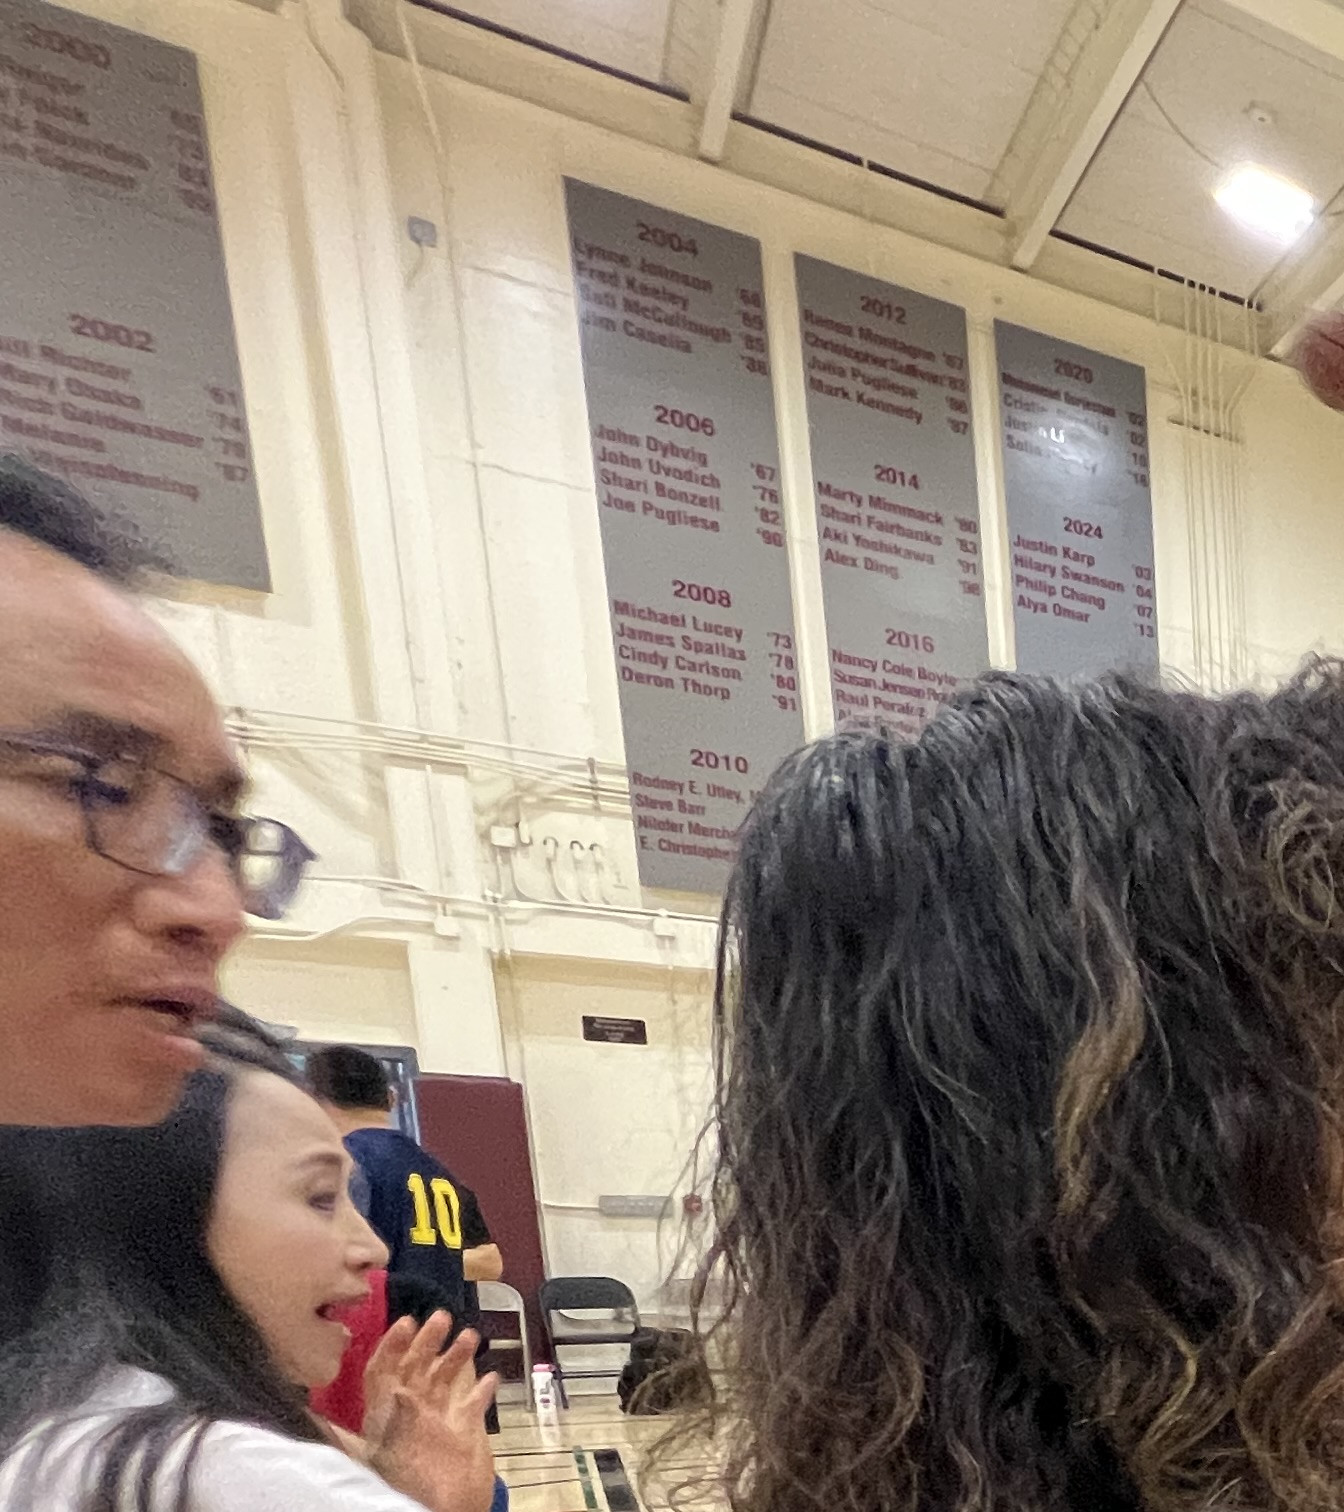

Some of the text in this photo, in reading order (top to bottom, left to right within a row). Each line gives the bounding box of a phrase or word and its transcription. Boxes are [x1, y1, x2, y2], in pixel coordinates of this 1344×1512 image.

[635, 218, 699, 258] 2004
[859, 294, 908, 326] 2012
[68, 312, 158, 354] 2002
[1054, 357, 1095, 385] 2020
[809, 375, 852, 401] Mark
[653, 402, 717, 438] 2006
[599, 446, 644, 472] John
[873, 463, 921, 492] 2014
[817, 480, 864, 509] Marty
[1063, 516, 1105, 541] 2024
[824, 547, 860, 569] Alex
[1013, 534, 1059, 557] Justin
[1061, 545, 1097, 569] Karp
[1014, 553, 1058, 580] Hilary
[1061, 564, 1126, 594] Swanson
[671, 577, 733, 610] 2008
[1015, 573, 1058, 599] Philip
[1061, 585, 1106, 612] Chang
[613, 599, 794, 651] Michael Lucey '73
[617, 621, 677, 649] James
[884, 626, 936, 654] 2016
[618, 644, 670, 671] Cindy
[675, 655, 743, 685] Carlson
[831, 649, 879, 674] Nancy
[882, 658, 914, 680] Cole
[621, 665, 676, 691] Deron
[680, 676, 732, 702] Thorp
[833, 669, 877, 691] Susan
[835, 688, 870, 708] Raul
[689, 747, 749, 775] 2010
[632, 770, 686, 797] Rodney
[635, 792, 706, 817] Steve Barr
[406, 1172, 464, 1250] 10
